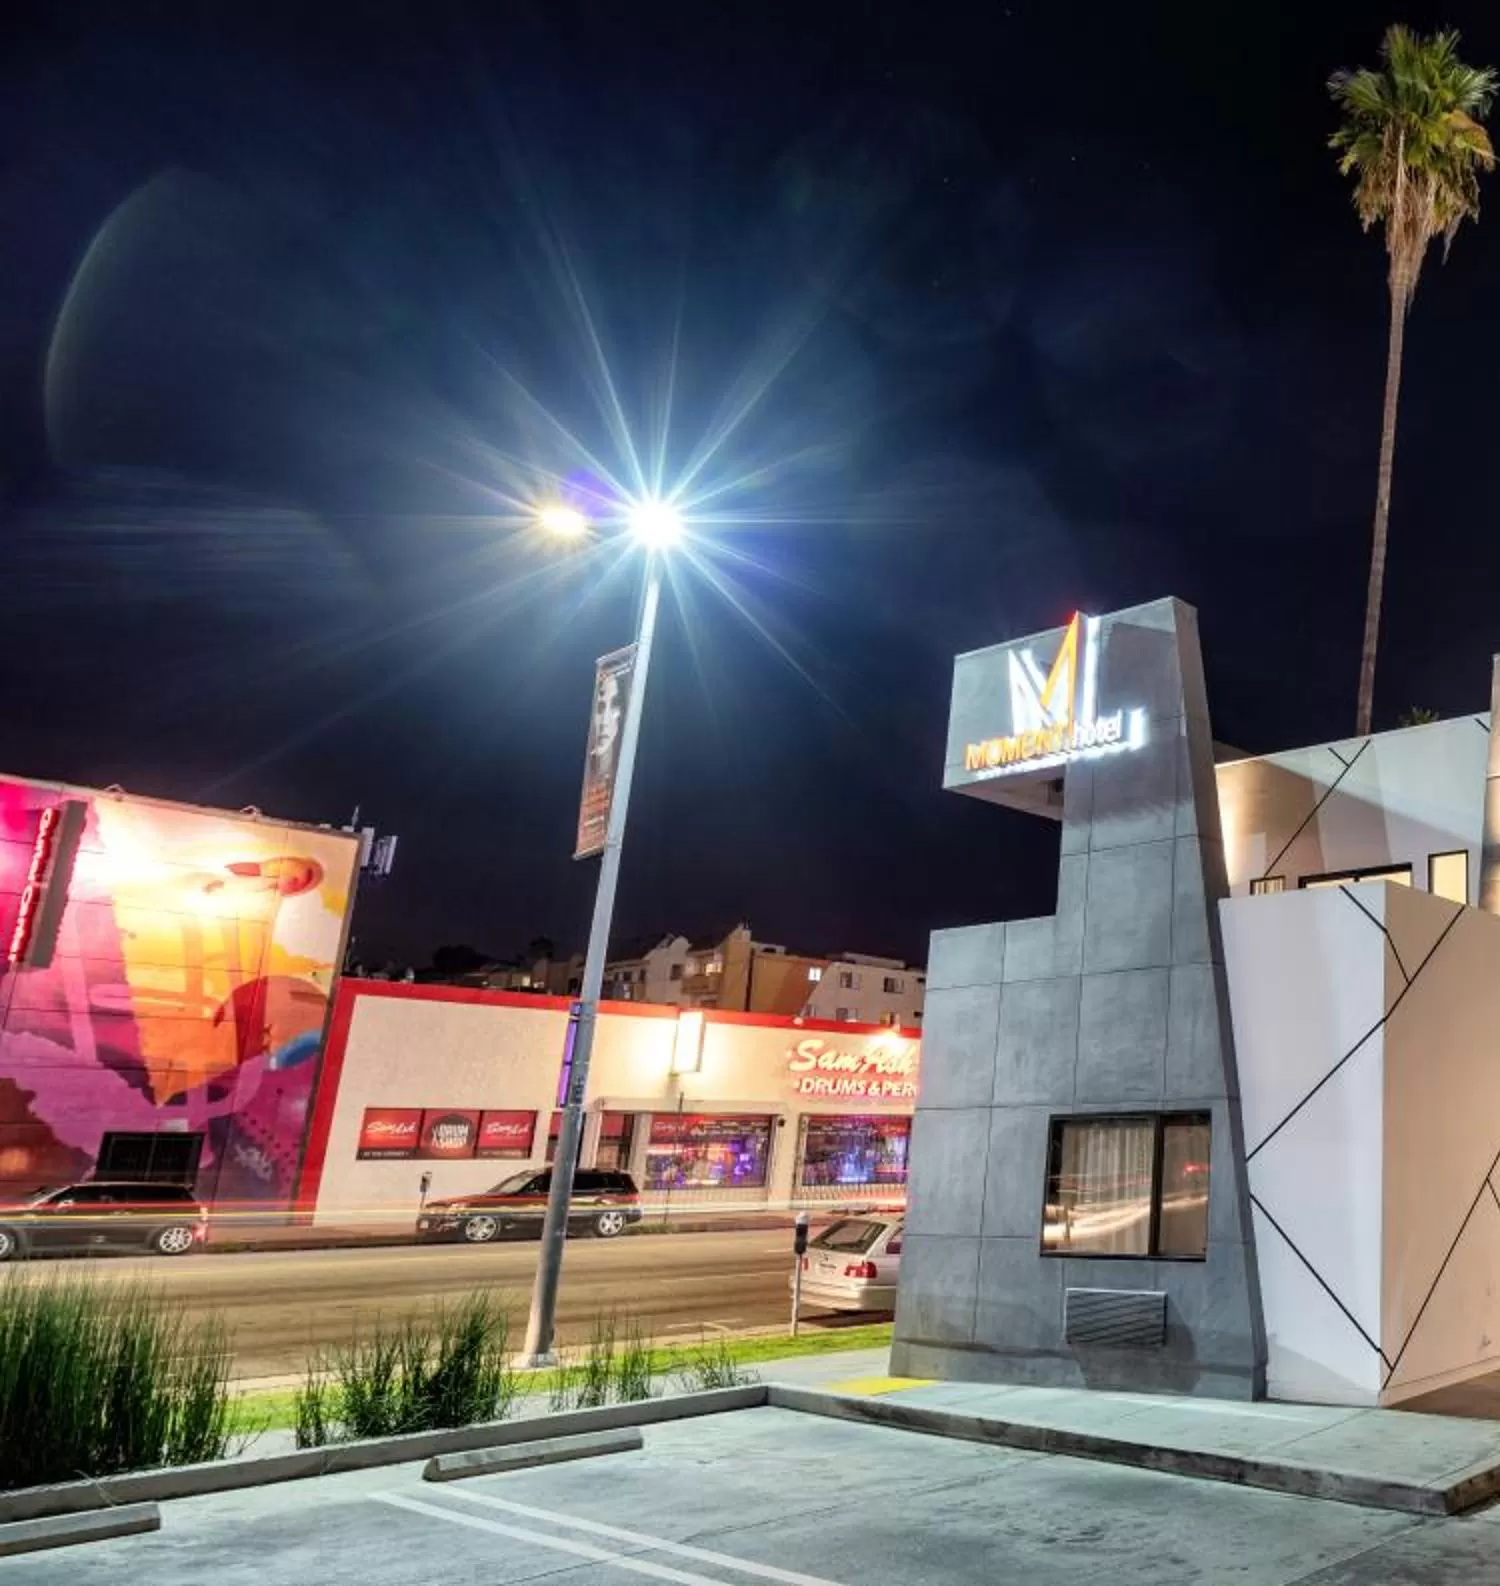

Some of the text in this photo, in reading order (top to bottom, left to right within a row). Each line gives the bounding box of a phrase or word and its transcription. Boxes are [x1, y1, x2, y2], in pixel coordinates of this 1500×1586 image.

[1071, 708, 1123, 750] hotel
[788, 1039, 858, 1073] Sam
[801, 1077, 866, 1095] DRUMS
